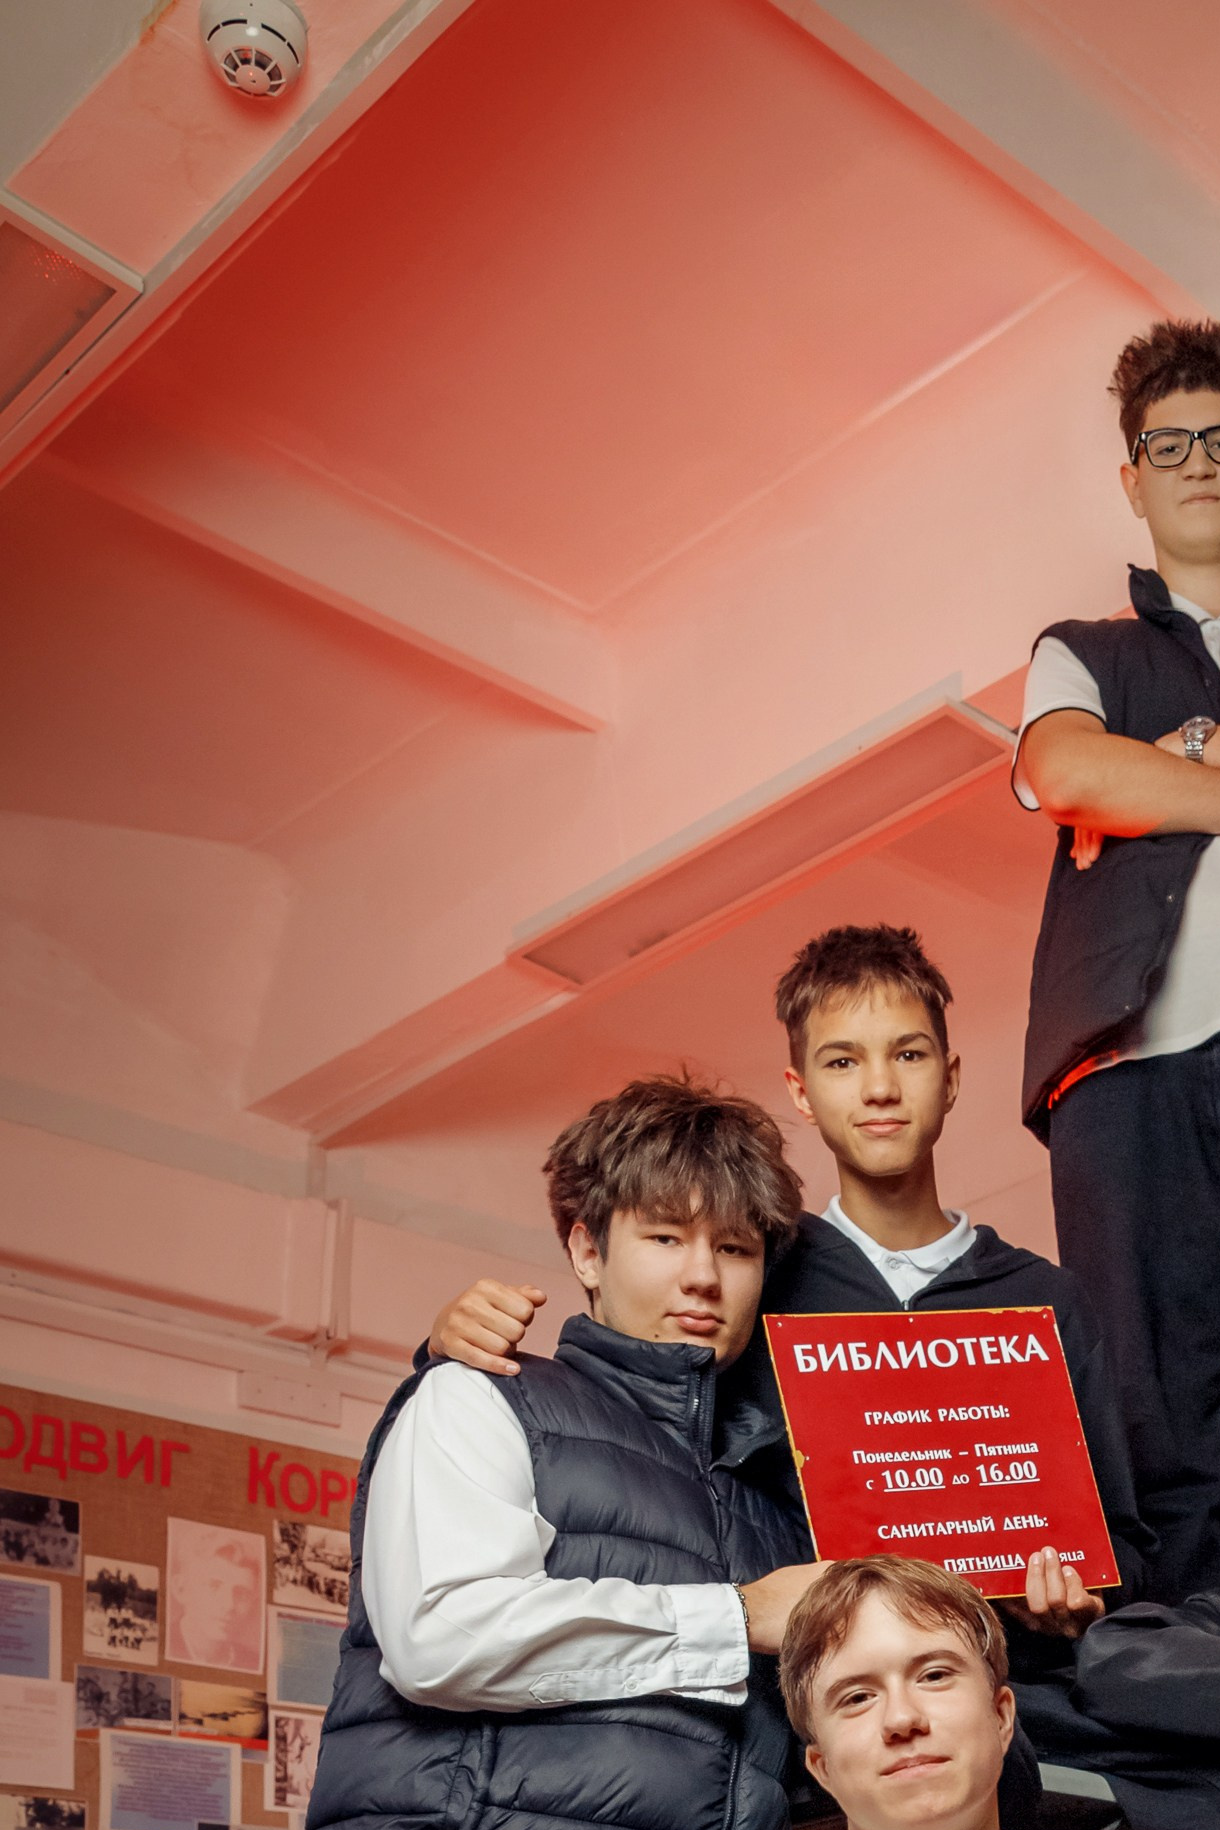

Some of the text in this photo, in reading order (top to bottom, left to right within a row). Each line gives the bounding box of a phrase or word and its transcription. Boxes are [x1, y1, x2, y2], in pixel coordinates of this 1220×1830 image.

[792, 1333, 1050, 1374] БИБЛИОТЕКА
[863, 1404, 1011, 1426] ГРАФИК РАБОТЫ:
[852, 1447, 953, 1465] Понедельник
[973, 1441, 1040, 1458] Пятница
[247, 1445, 358, 1517] КОР
[865, 1460, 1039, 1491] с 10.00 до 16.00
[876, 1513, 1049, 1540] САНИТАРНЫЙ ДЕНЬ:
[943, 1553, 1026, 1573] ПЯТНИЦА
